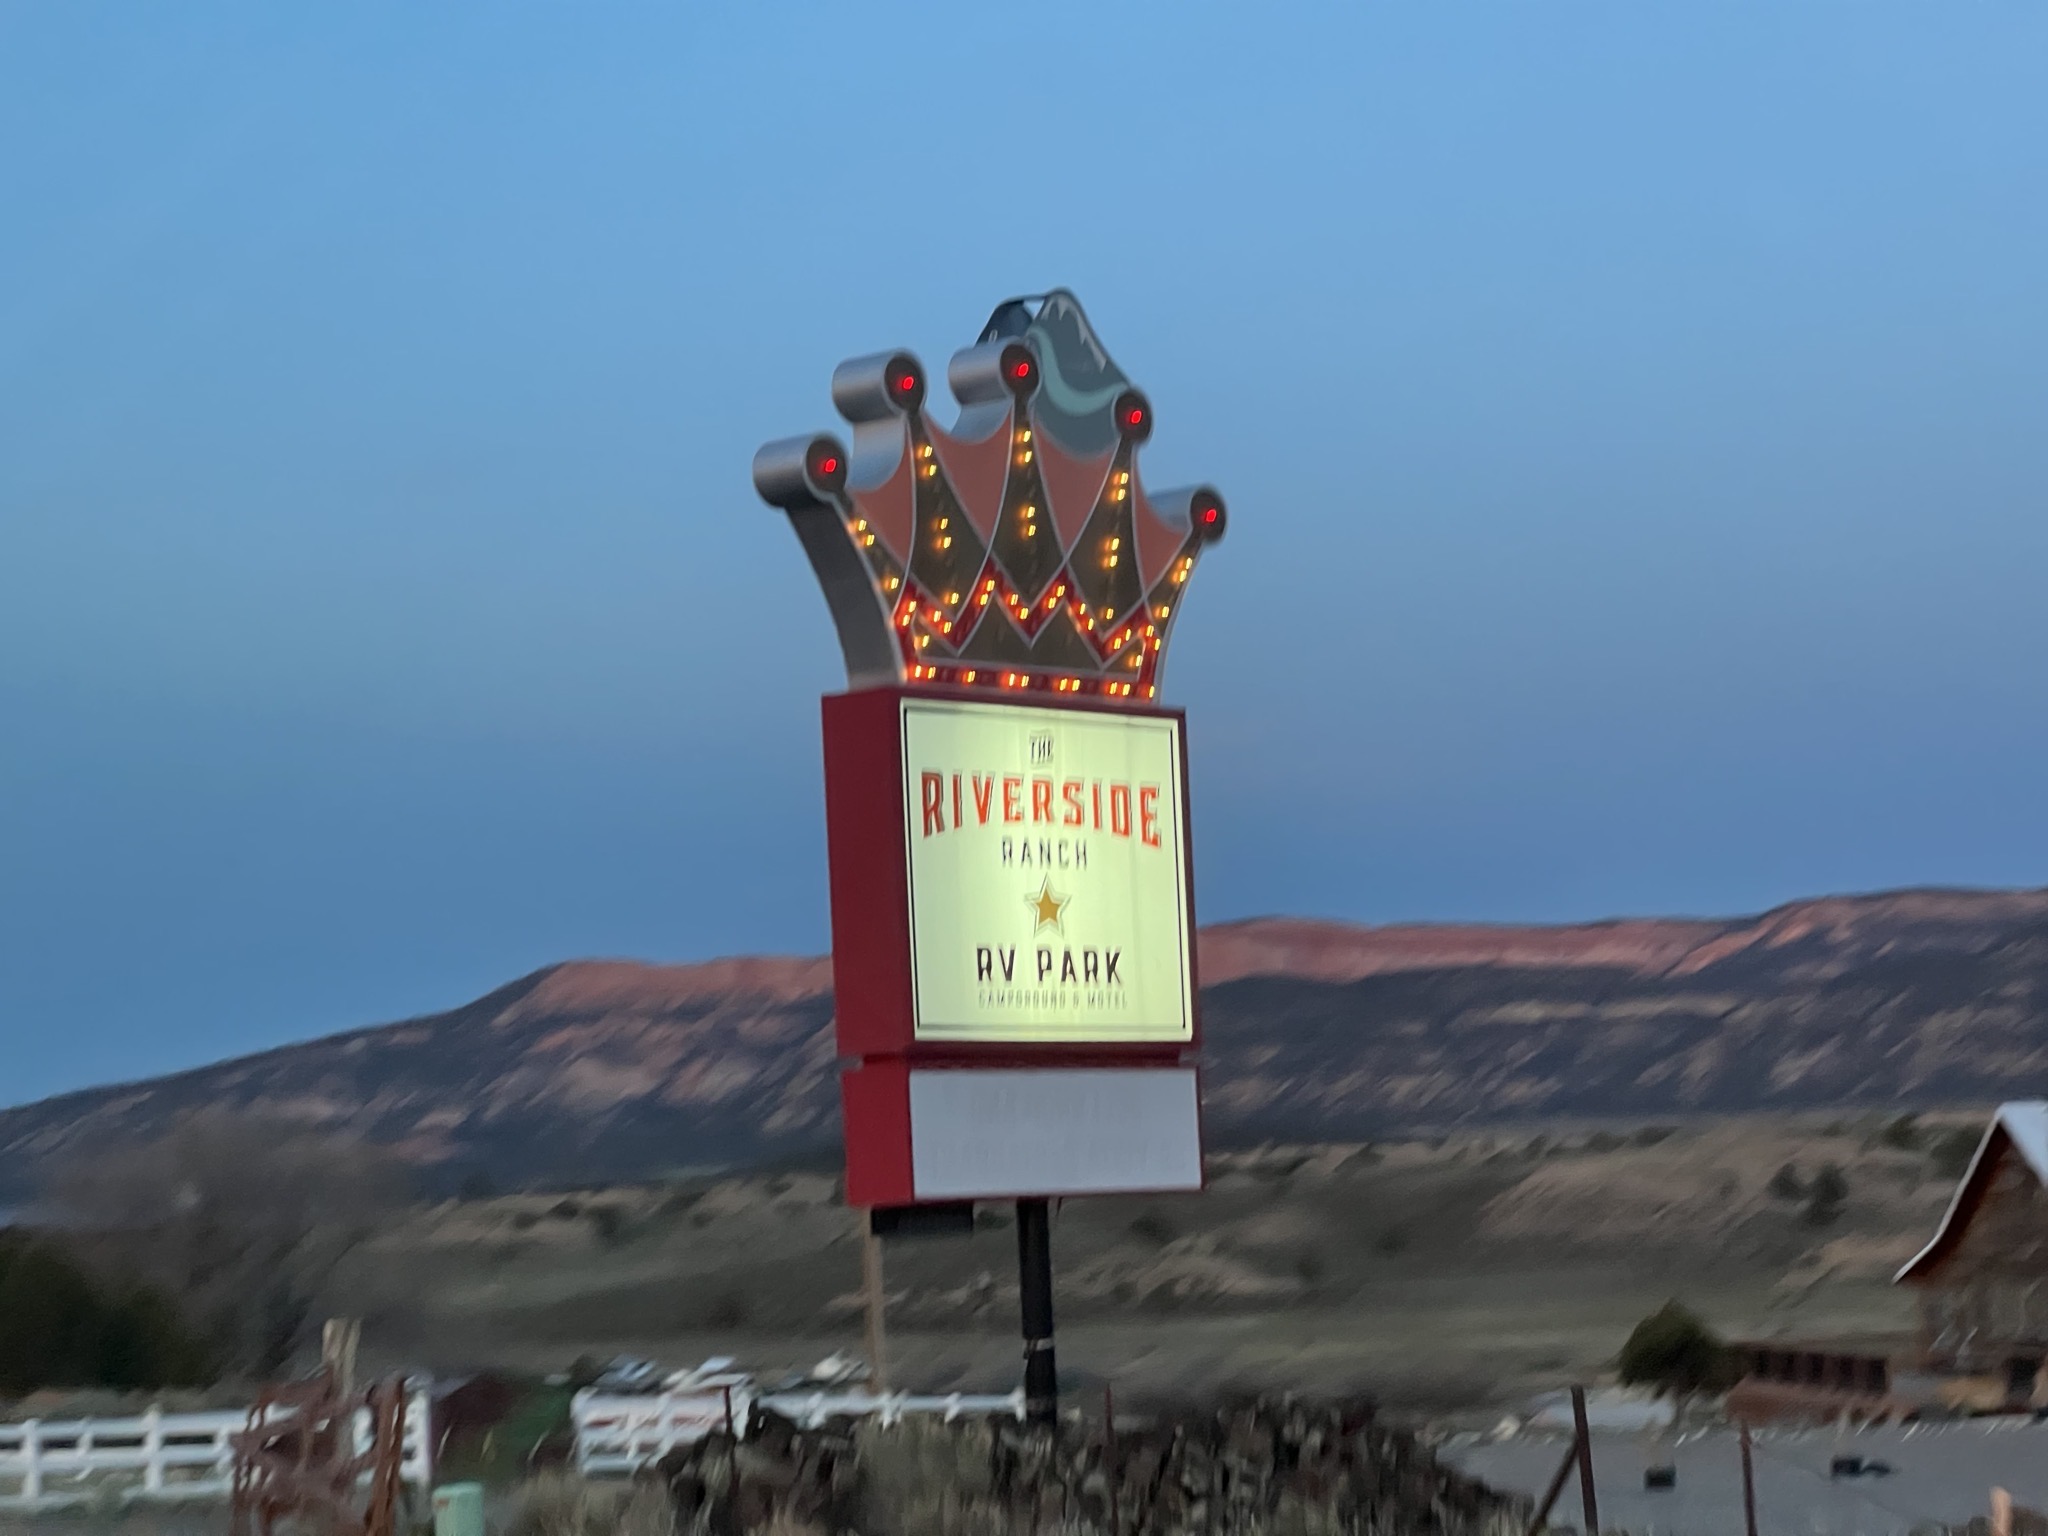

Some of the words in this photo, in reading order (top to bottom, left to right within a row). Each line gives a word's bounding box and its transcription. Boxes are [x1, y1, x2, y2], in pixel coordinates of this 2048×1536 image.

[1029, 733, 1054, 766] THE
[921, 769, 1162, 848] RIVERSIDE
[1002, 836, 1087, 870] RANCH
[976, 944, 1016, 986] RV
[1037, 946, 1122, 986] PARK
[979, 988, 1066, 1011] CAMPGROUND
[1086, 989, 1128, 1011] MOTEL
